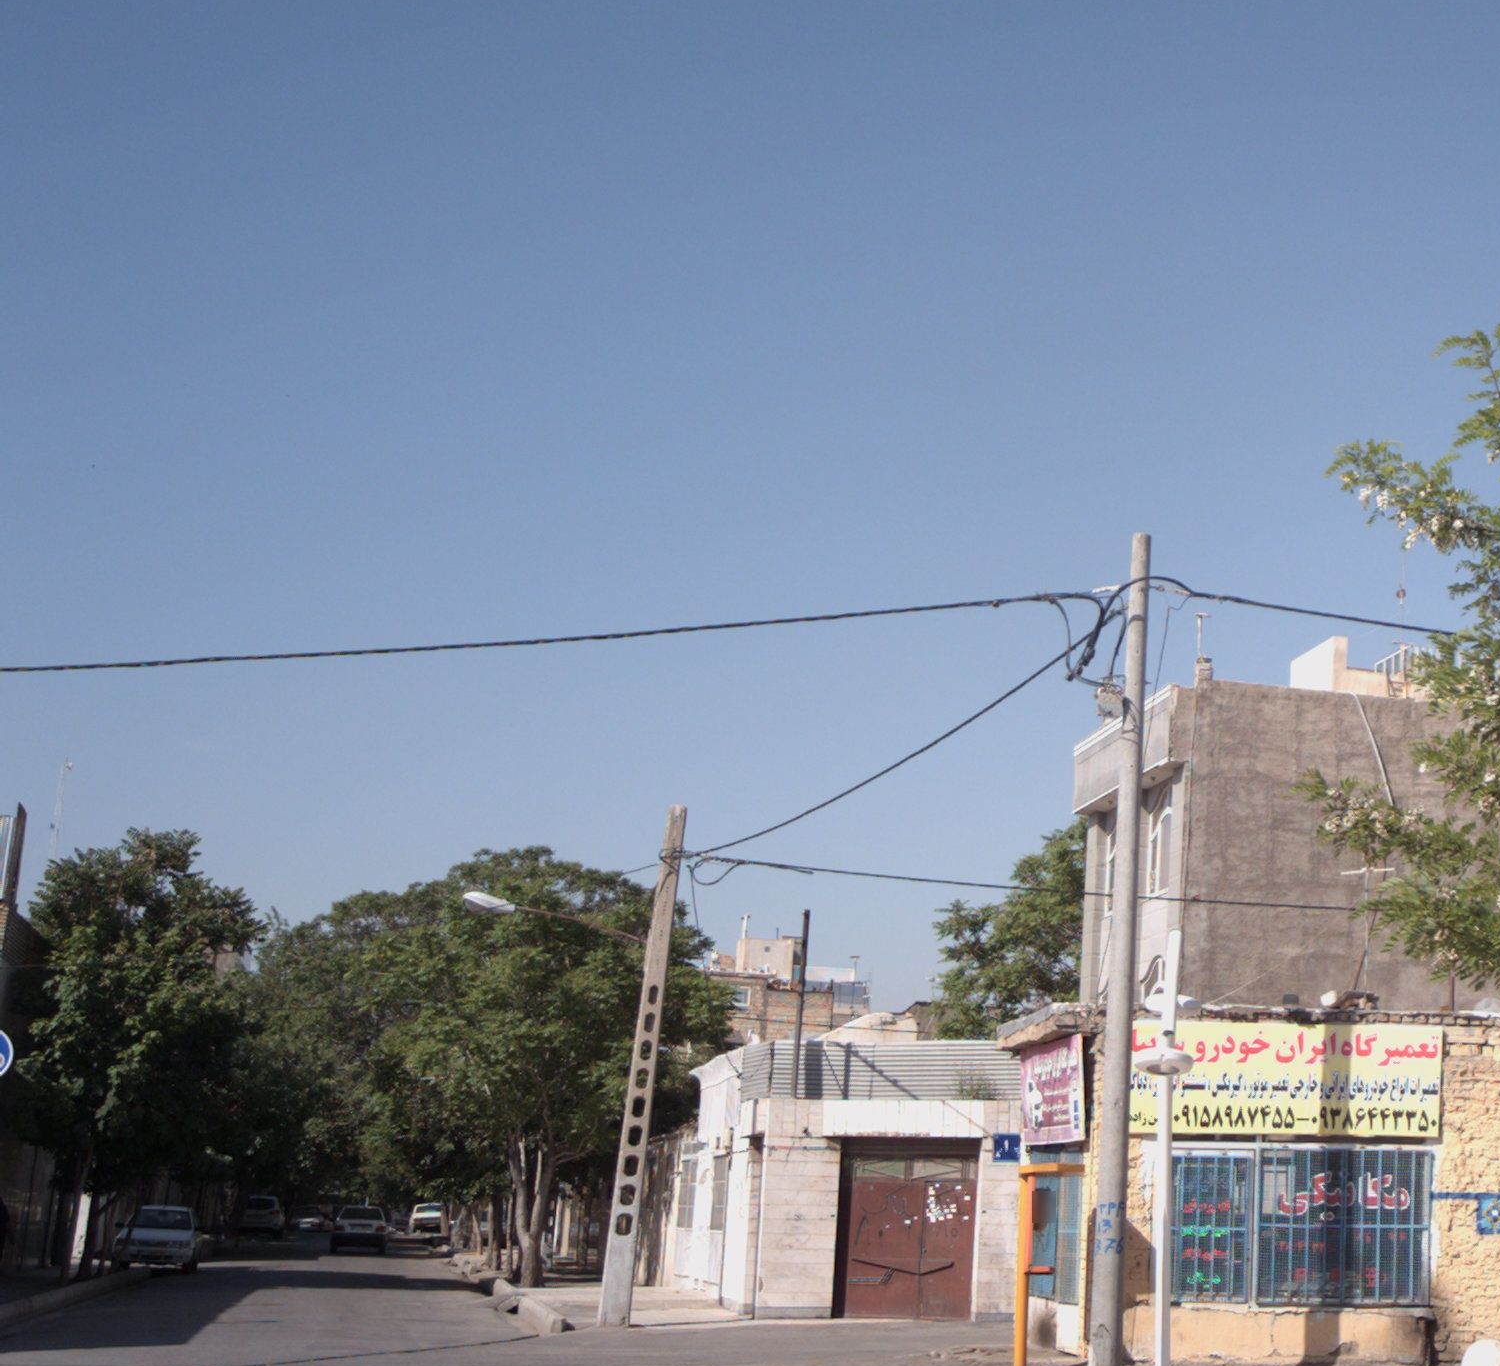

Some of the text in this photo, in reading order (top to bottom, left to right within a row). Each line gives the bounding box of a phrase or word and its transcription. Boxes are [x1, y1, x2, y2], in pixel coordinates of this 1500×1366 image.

[1193, 1030, 1270, 1063] خودرو
[1276, 1031, 1337, 1064] ایران
[1341, 1033, 1377, 1056] گاه
[1378, 1036, 1440, 1066] تعمیر
[1278, 1171, 1411, 1221] مکانیکی
